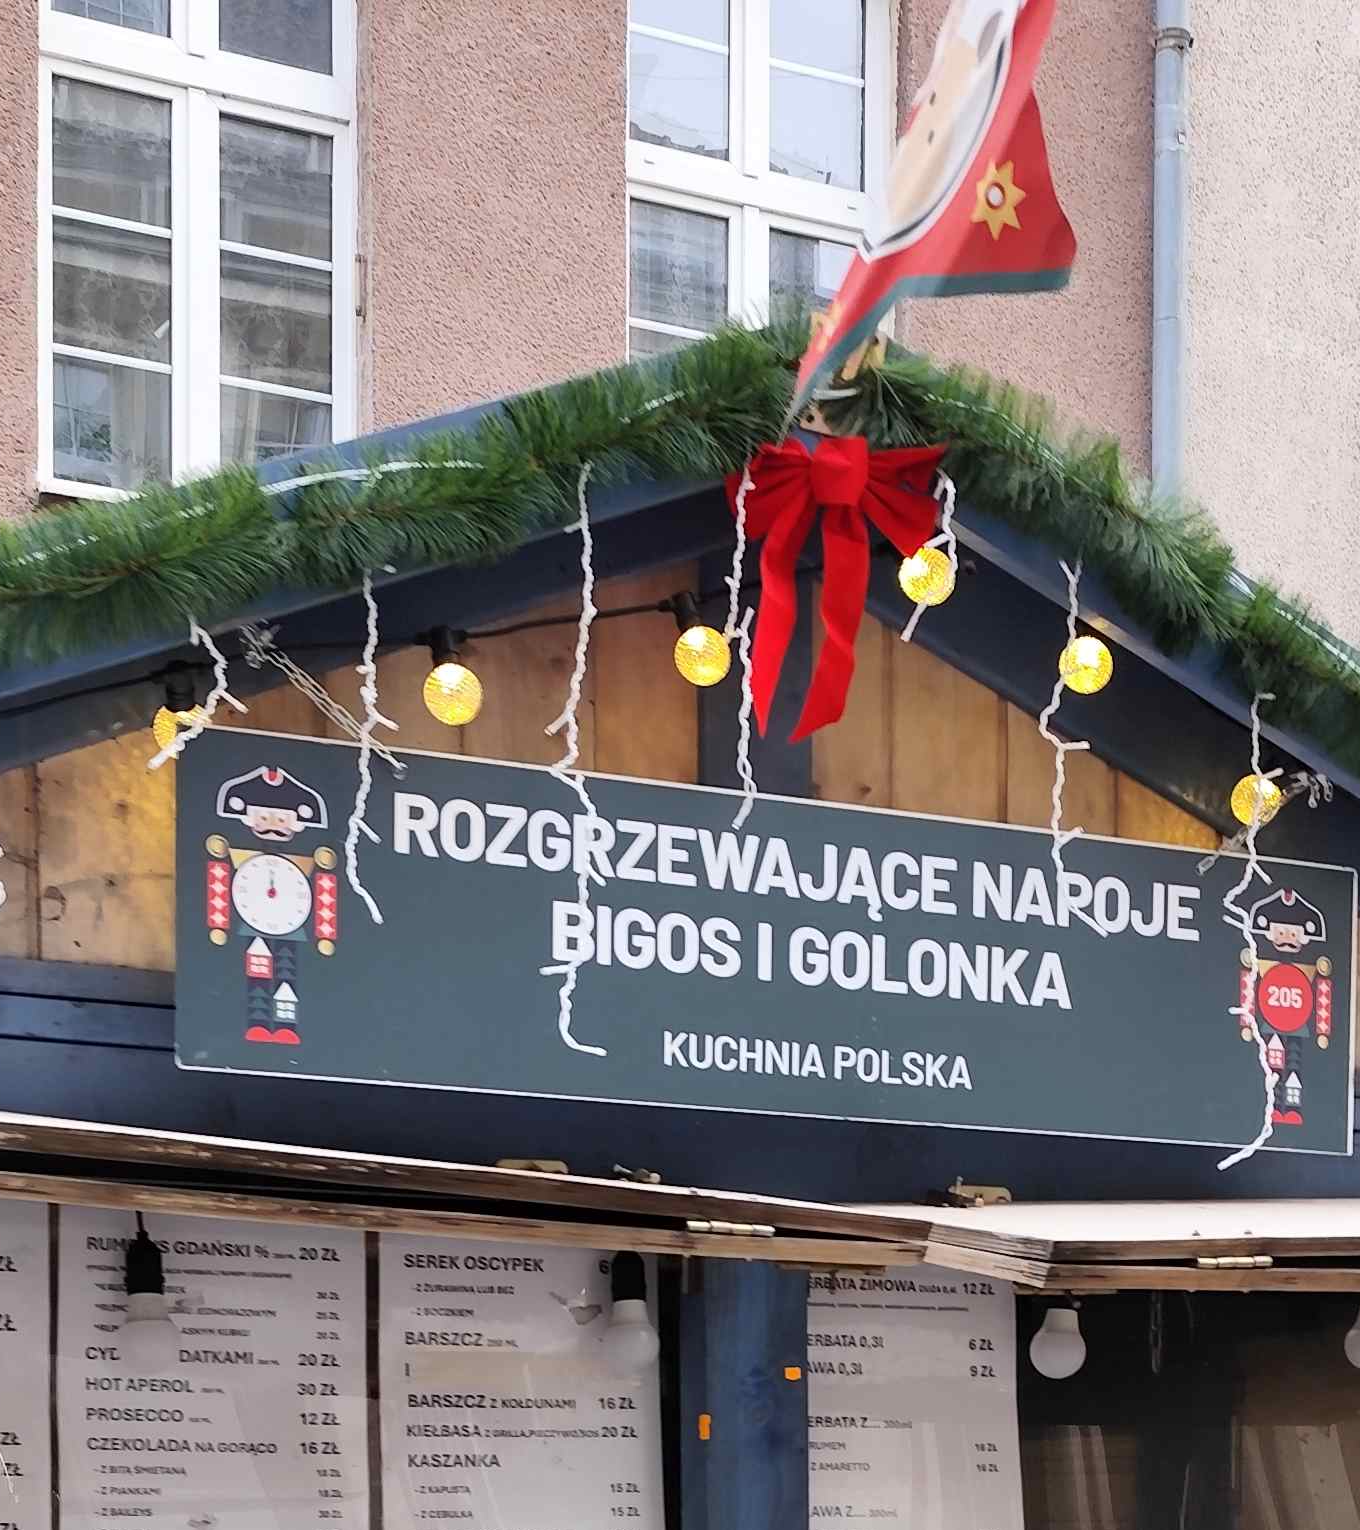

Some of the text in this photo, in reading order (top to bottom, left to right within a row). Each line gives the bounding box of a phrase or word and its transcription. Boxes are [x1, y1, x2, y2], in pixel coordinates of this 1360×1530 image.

[392, 791, 958, 922] ROZGRZEWAJĄCE
[552, 901, 1073, 1010] BIGOS I GOLONKA
[1266, 984, 1303, 1008] 205
[662, 1030, 973, 1091] KUCHNIA POLSKA
[173, 1239, 252, 1258] GDAŃSKI
[299, 1247, 317, 1261] 20
[322, 1247, 341, 1262] ZŁ
[403, 1254, 460, 1270] SEREK
[463, 1256, 544, 1273] OSCYPEK
[808, 1276, 856, 1291] ERBATA
[860, 1278, 916, 1293] ZIMOWA
[963, 1283, 978, 1295] 12
[980, 1284, 996, 1296] ZŁ
[405, 1331, 483, 1347] BARSZCZ
[807, 1333, 995, 1351] ERBATA 6 ZŁ
[179, 1349, 254, 1364] DATKAMI
[297, 1353, 317, 1367] 20
[321, 1353, 342, 1368] ZŁ
[807, 1361, 996, 1378] AWA 9 ZŁ
[85, 1377, 123, 1391] HOT
[126, 1378, 195, 1393] APEROL
[297, 1383, 317, 1397] 30
[320, 1383, 340, 1397] ZŁ
[407, 1394, 487, 1409] BARSZCZ
[489, 1399, 497, 1409] Z
[597, 1397, 616, 1410] 16
[618, 1397, 637, 1410] ZŁ
[86, 1407, 184, 1423] PROSECCO
[300, 1412, 318, 1425] 12
[321, 1412, 342, 1426] ZŁ
[808, 1416, 857, 1428] ERBATA
[0, 1432, 22, 1446] ZŁ
[406, 1424, 638, 1438] KIEŁBASA 20 ZŁ
[87, 1437, 192, 1453] CZEKOLADA
[195, 1442, 215, 1454] NA
[300, 1442, 318, 1455] 16
[321, 1442, 342, 1456] ZŁ
[407, 1454, 501, 1468] KASZANKA
[819, 1462, 871, 1471] AMARETTO
[610, 1483, 624, 1493] 15
[626, 1483, 641, 1494] ZŁ
[611, 1507, 641, 1517] 15 ZŁ
